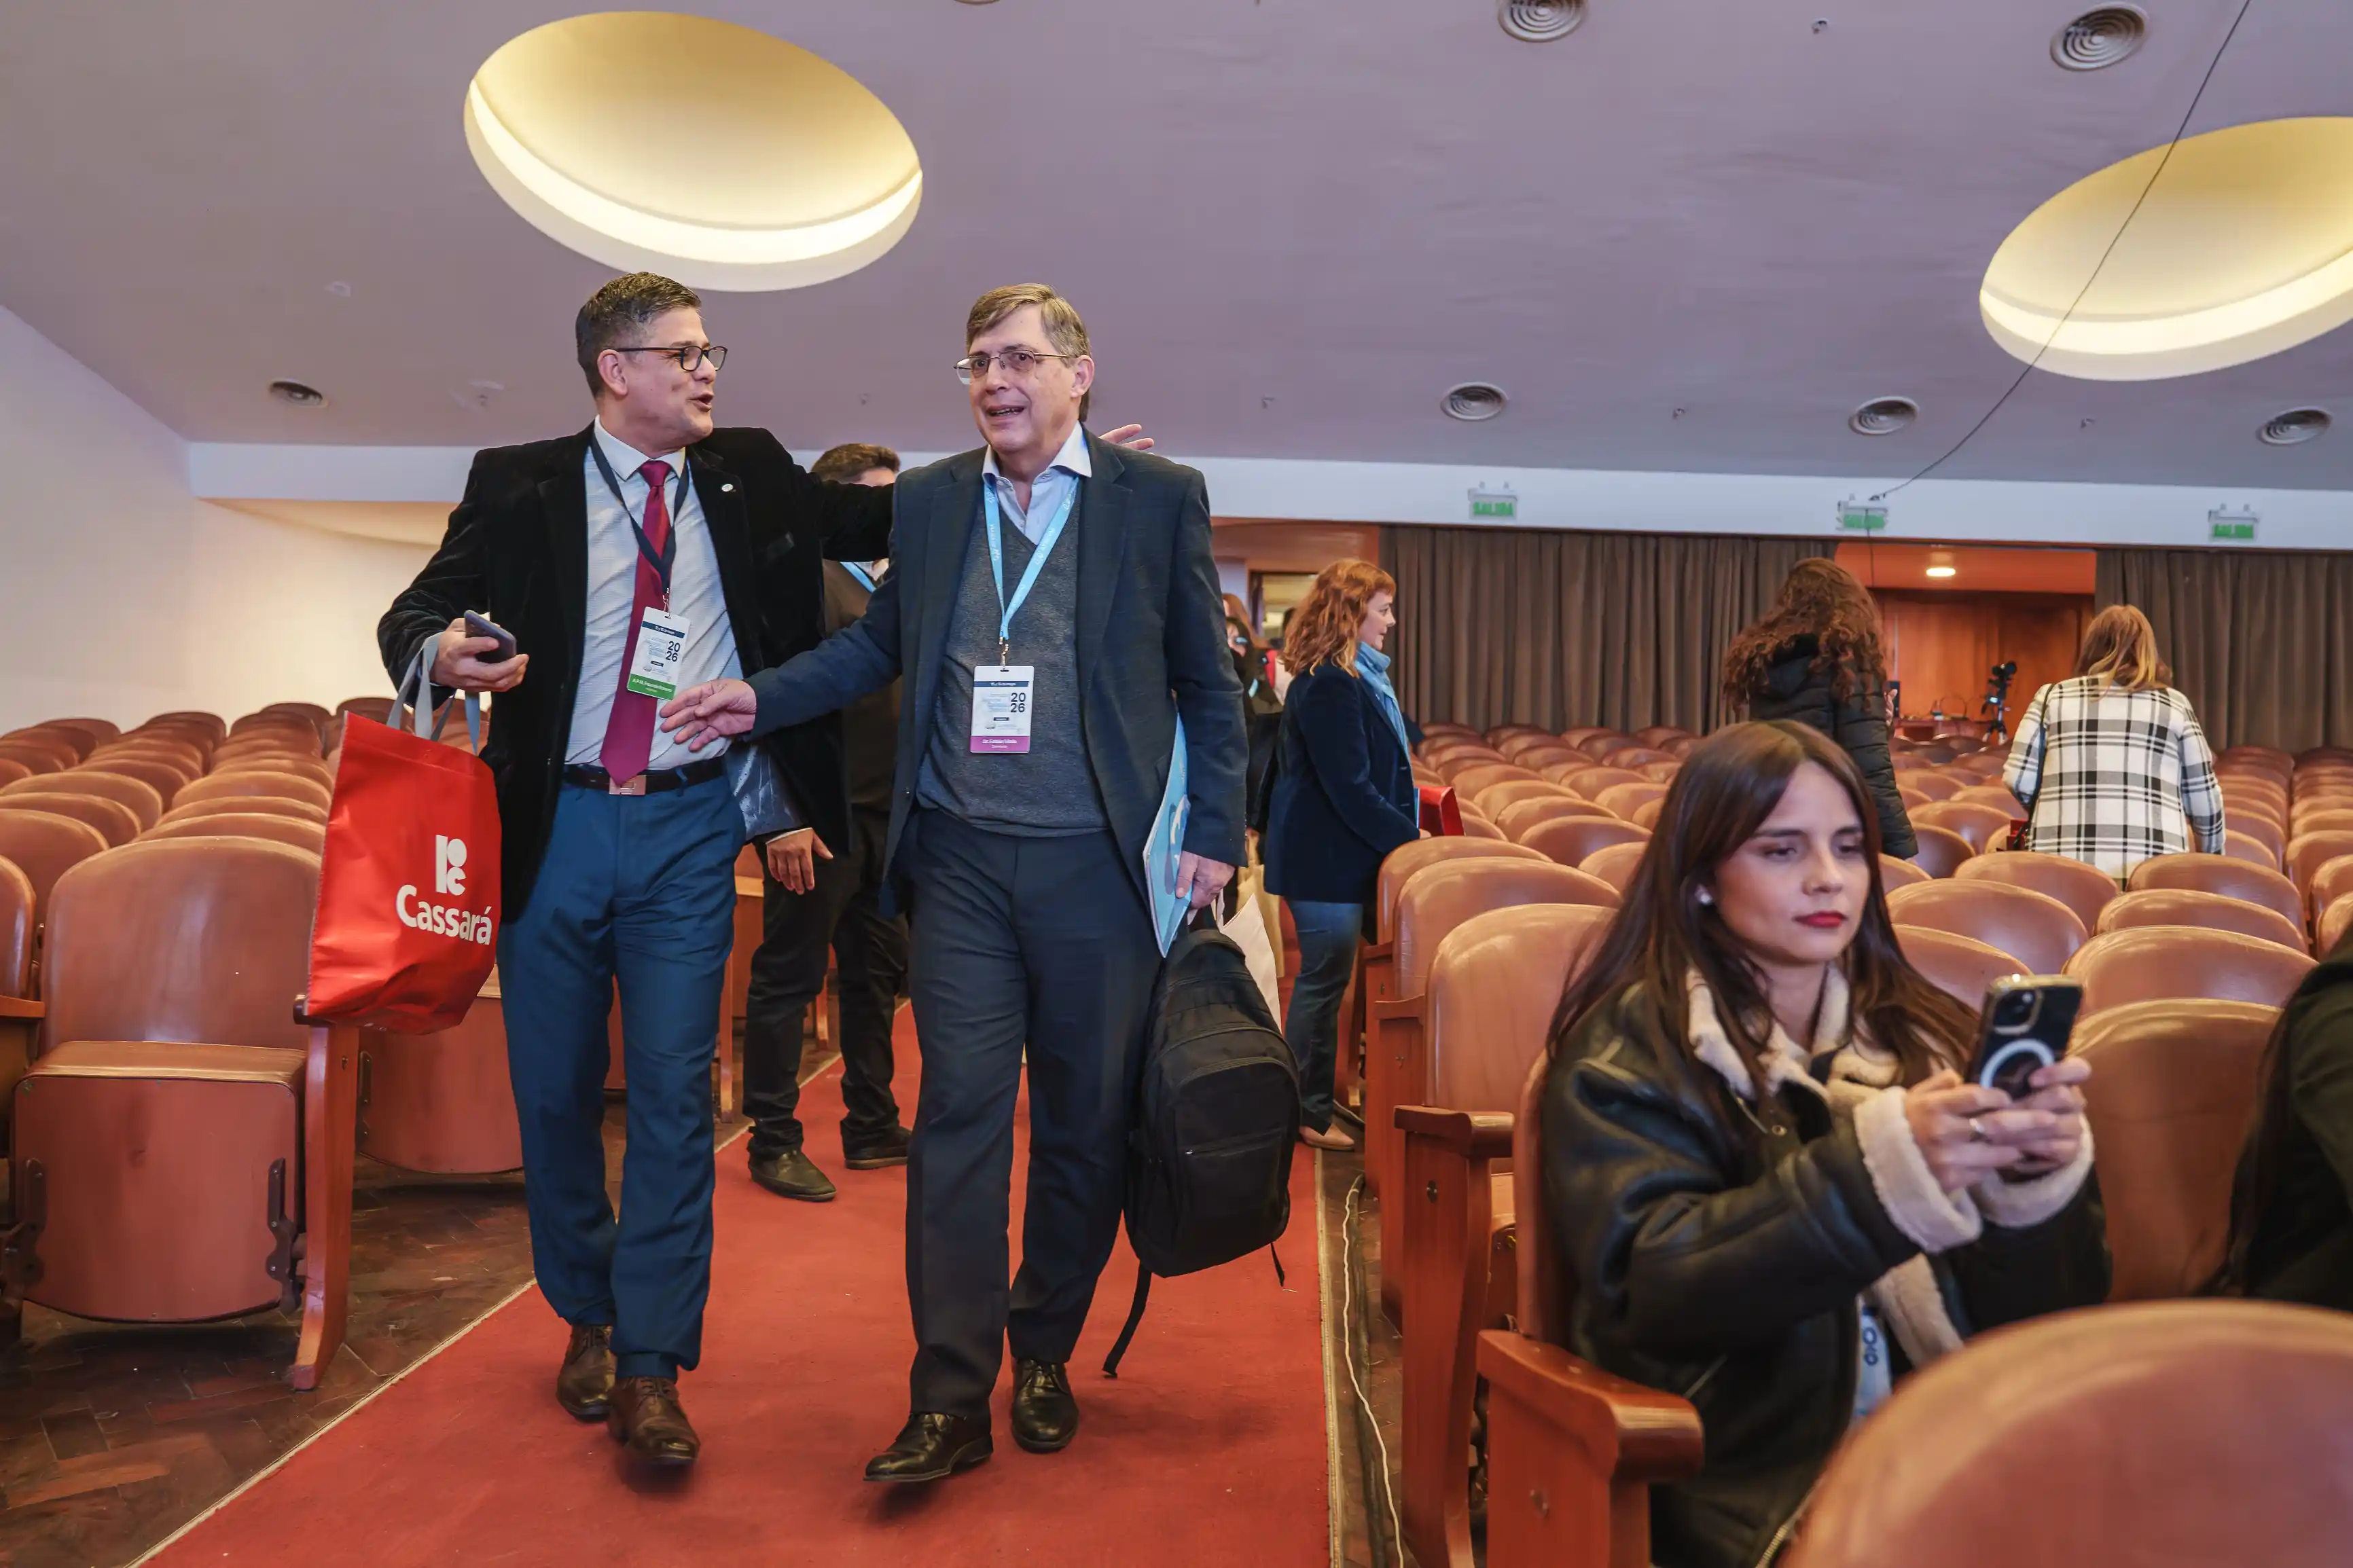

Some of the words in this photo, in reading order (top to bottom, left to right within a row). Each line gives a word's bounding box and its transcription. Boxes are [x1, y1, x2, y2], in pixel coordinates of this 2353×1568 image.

[667, 640, 681, 653] 20
[665, 650, 679, 662] 26
[1010, 692, 1026, 703] 20
[1010, 702, 1026, 713] 26
[395, 884, 492, 945] Cassará
